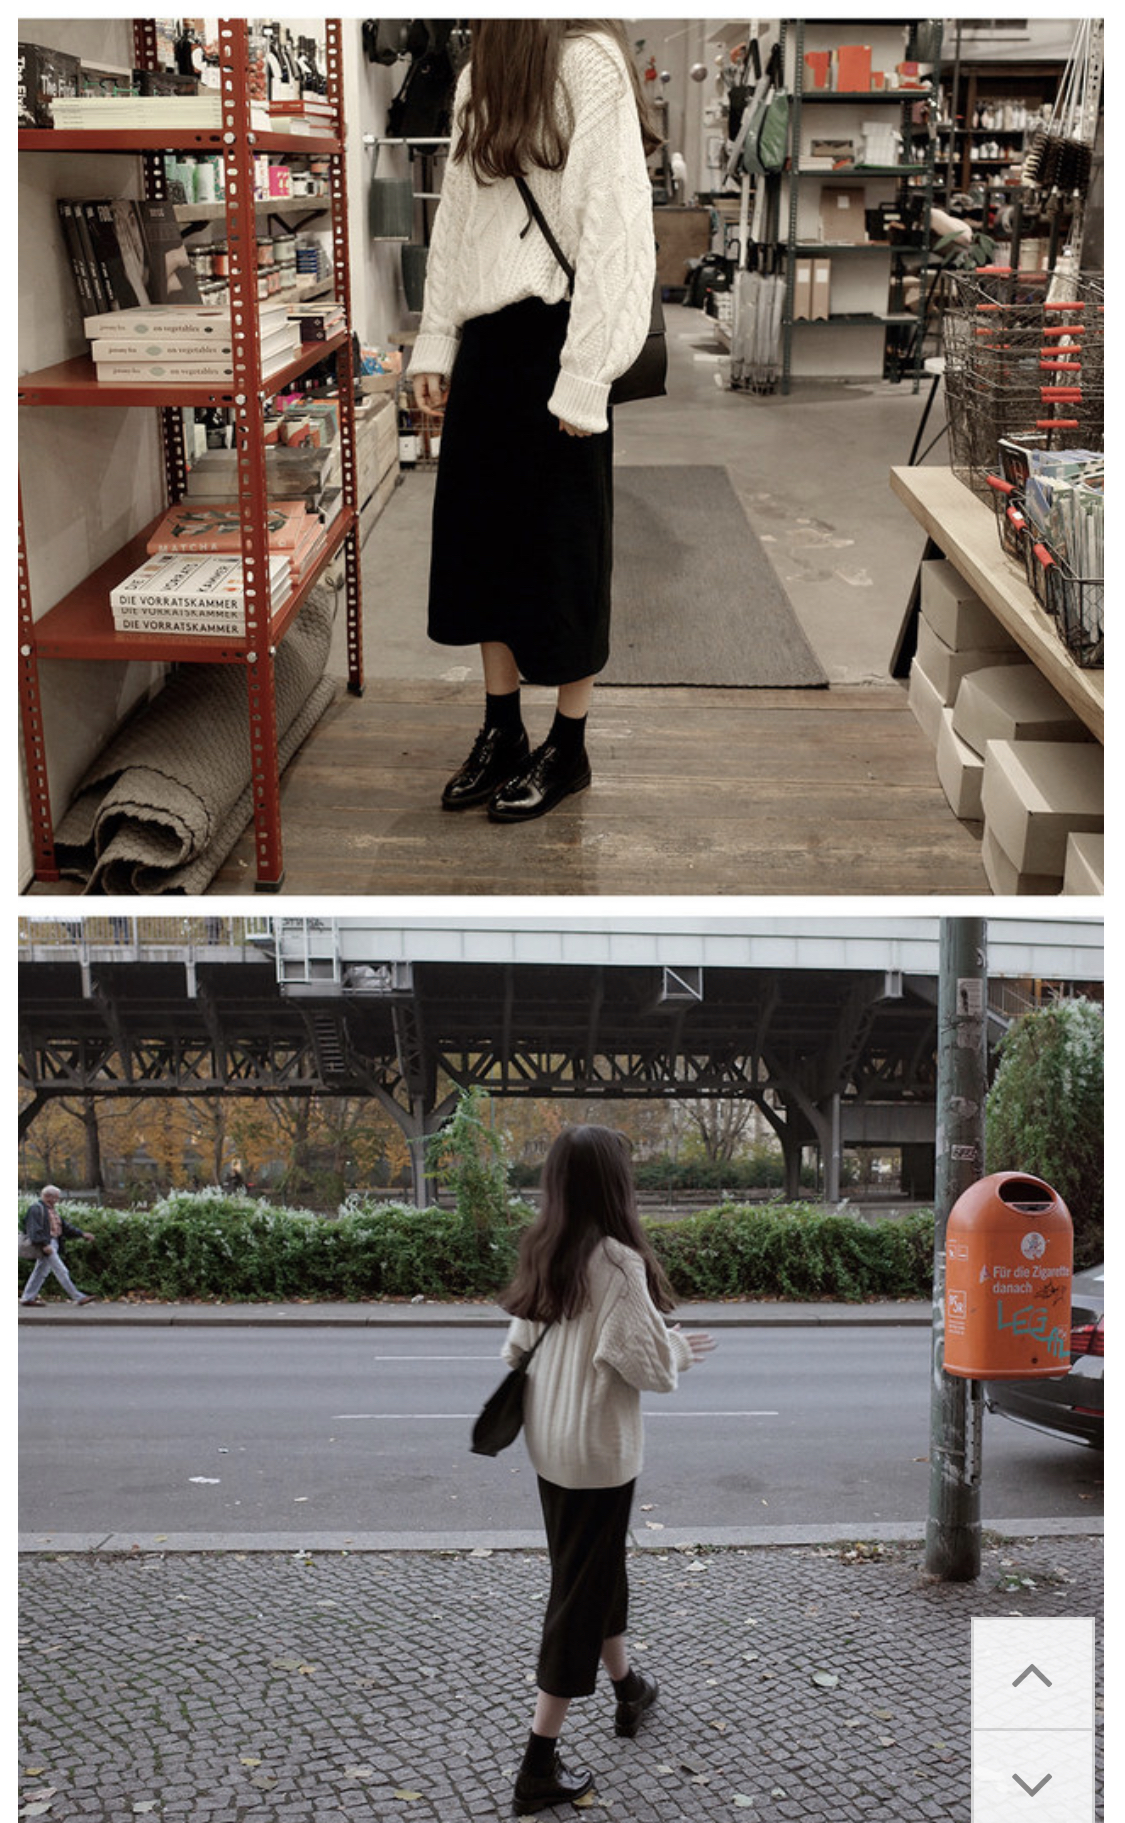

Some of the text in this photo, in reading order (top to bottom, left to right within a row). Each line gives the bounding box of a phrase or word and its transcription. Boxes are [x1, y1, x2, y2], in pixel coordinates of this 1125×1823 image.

[164, 325, 200, 333] vegetables
[181, 368, 219, 376] vegetables
[158, 543, 219, 553] MATCHA
[120, 596, 238, 609] DIE VORRATSKAMMER
[123, 620, 239, 634] DIE VORRATSKAMMER
[993, 1265, 1070, 1281] Für die Zigarette
[992, 1281, 1033, 1293] danach
